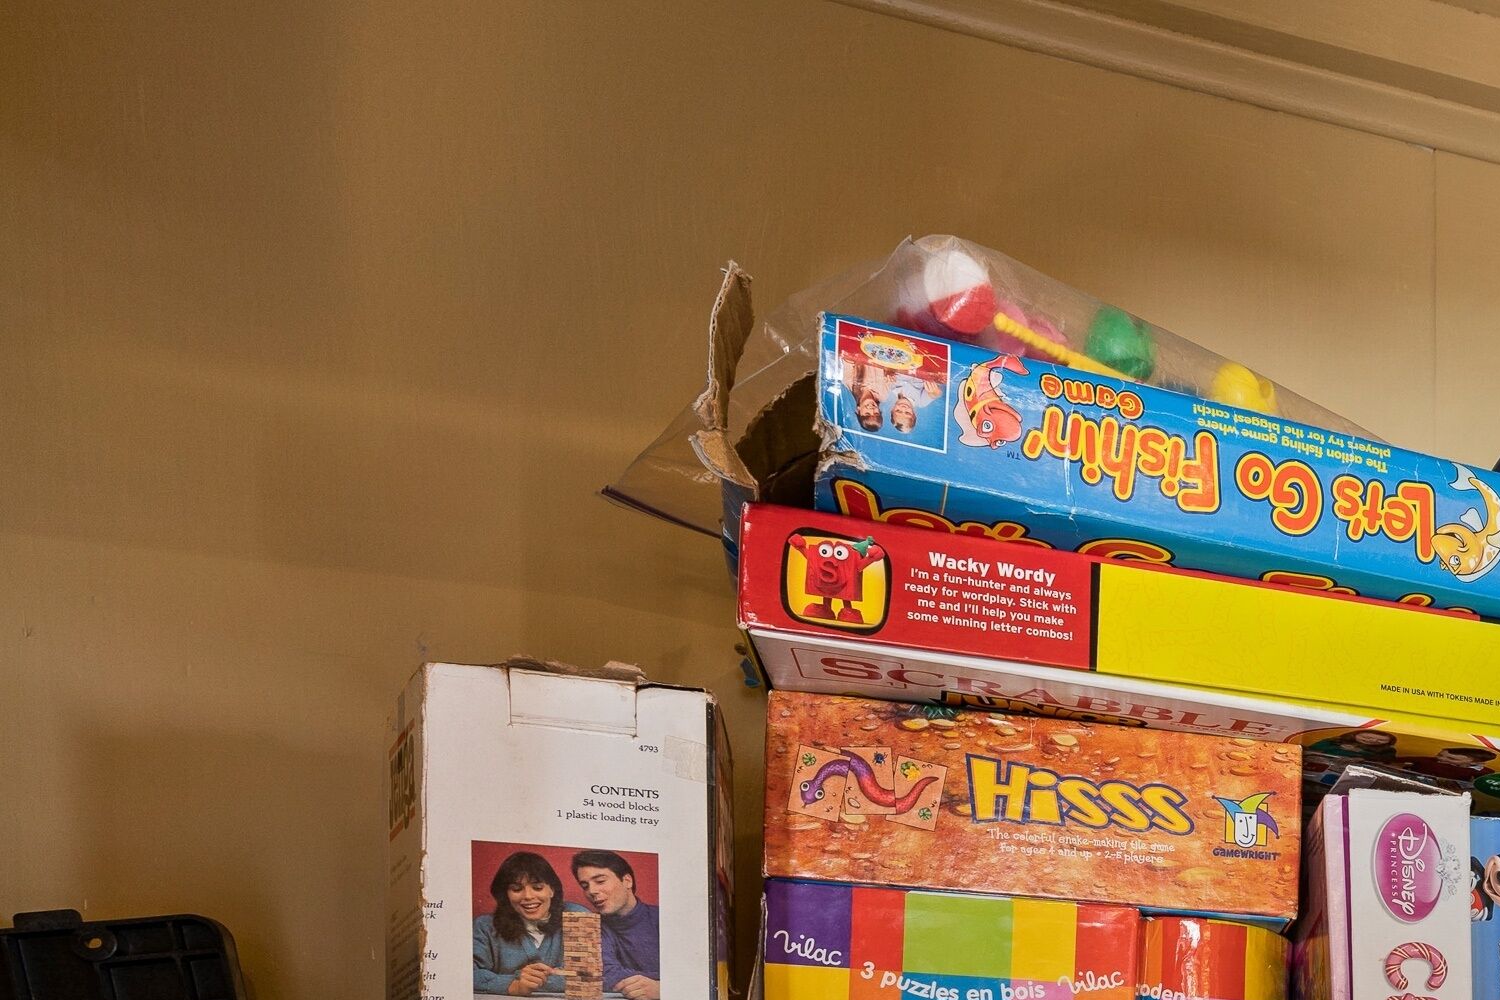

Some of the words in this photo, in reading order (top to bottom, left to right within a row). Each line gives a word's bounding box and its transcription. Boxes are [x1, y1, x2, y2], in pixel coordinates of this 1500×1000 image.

[1040, 373, 1143, 420] Game
[1023, 404, 1221, 512] Fishin'
[1236, 451, 1322, 535] Go
[1332, 473, 1435, 562] Let's
[910, 567, 929, 580] I'm
[932, 571, 940, 582] a
[943, 572, 1007, 592] fun-hunter
[1009, 582, 1030, 595] and
[1033, 586, 1072, 601] always
[928, 551, 990, 577] Wacky
[996, 561, 1056, 587] Wordy
[904, 581, 938, 597] ready
[941, 586, 959, 598] for
[961, 588, 1016, 607] wordplay.
[1019, 597, 1049, 611] Stick
[1052, 602, 1077, 615] with
[917, 598, 935, 608] me
[939, 600, 960, 612] and
[964, 603, 979, 615] I'll
[982, 605, 1007, 620] help
[1009, 610, 1031, 623] you
[1033, 612, 1064, 627] make
[907, 609, 939, 623] some
[942, 615, 988, 632] winning
[990, 620, 1023, 634] letter
[1025, 625, 1073, 641] combos!
[822, 655, 1271, 736] SCRABBLE
[1380, 684, 1401, 694] MADE
[1402, 687, 1411, 695] IN
[1411, 687, 1426, 697] USA
[1426, 690, 1445, 700] WITH
[1445, 692, 1474, 704] TOKENS
[1474, 696, 1495, 706] MADE
[638, 744, 660, 754] 4793
[582, 798, 595, 808] 54
[597, 800, 626, 811] wood
[628, 800, 660, 813] blocks
[590, 784, 660, 800] CONTENTS
[556, 810, 563, 819] 1
[565, 810, 598, 824] plastic
[600, 812, 637, 826] loading
[639, 816, 660, 827] tray
[1395, 822, 1427, 916] Disney
[860, 961, 875, 981] 3
